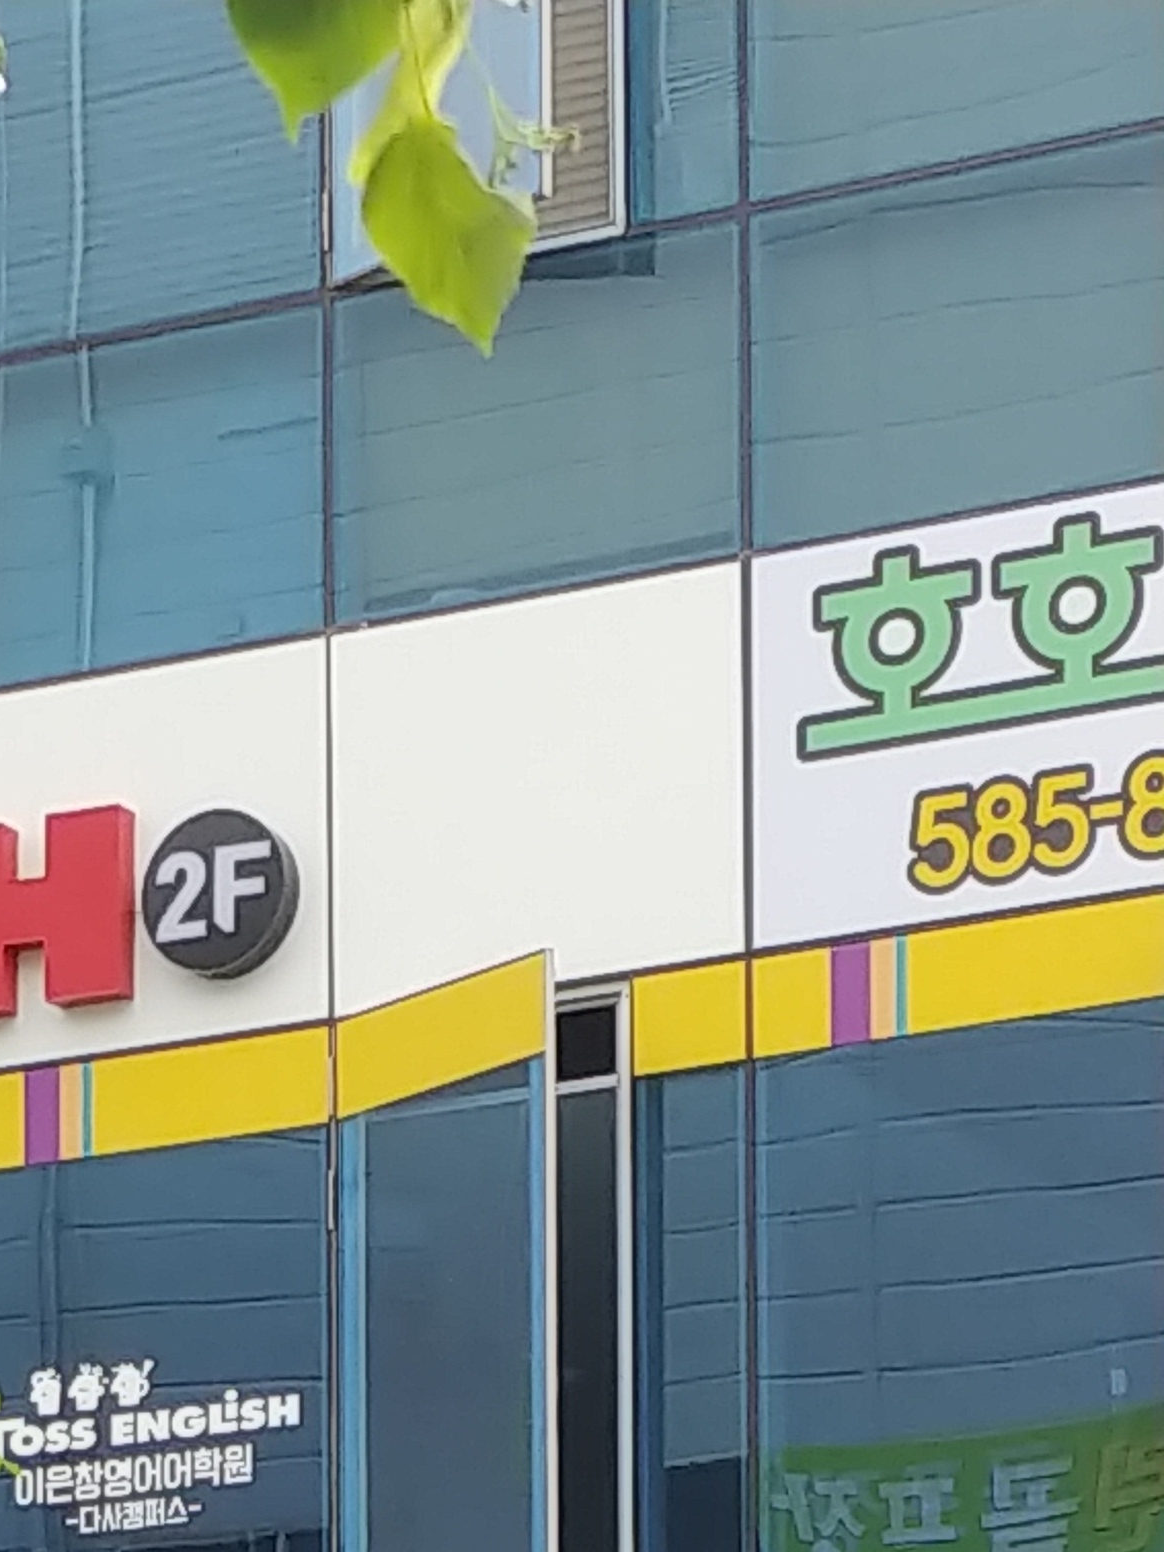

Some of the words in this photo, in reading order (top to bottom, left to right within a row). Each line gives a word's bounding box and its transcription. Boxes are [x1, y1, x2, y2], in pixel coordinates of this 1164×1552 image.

[797, 512, 1164, 760] 호호
[154, 838, 273, 945] 2F
[908, 750, 1164, 893] 585-8
